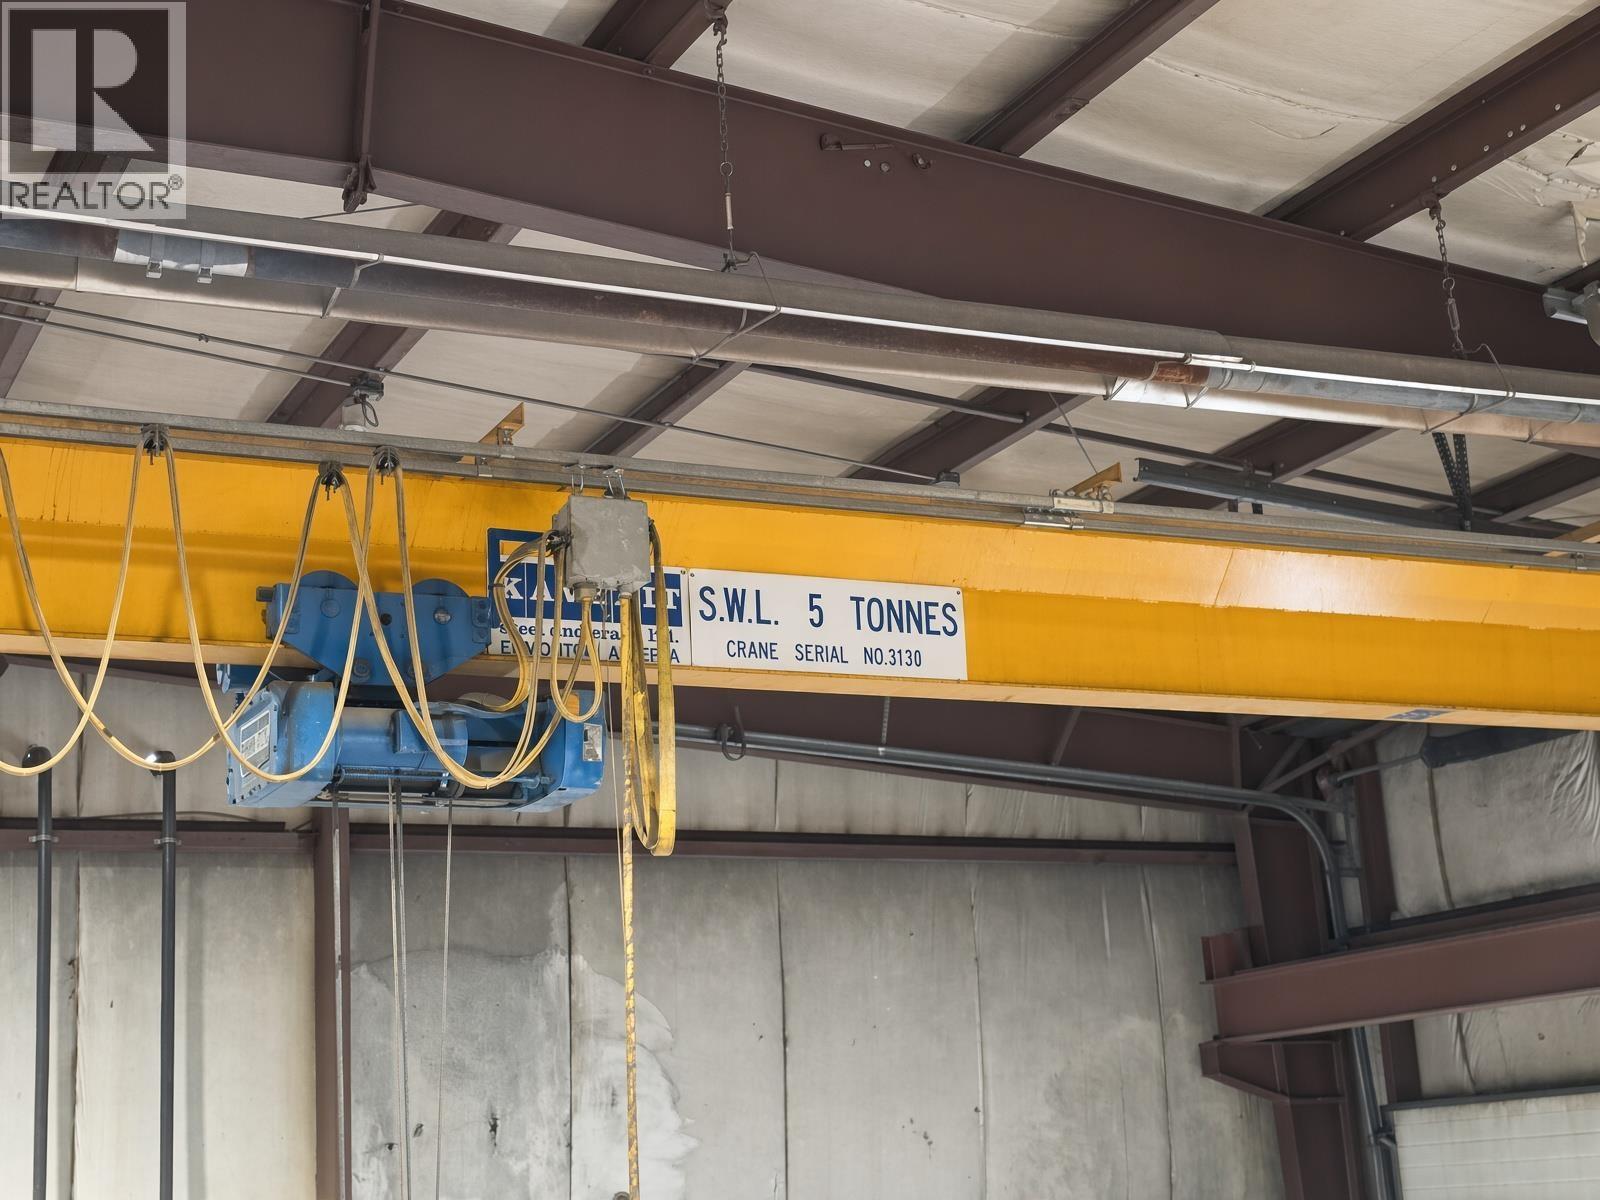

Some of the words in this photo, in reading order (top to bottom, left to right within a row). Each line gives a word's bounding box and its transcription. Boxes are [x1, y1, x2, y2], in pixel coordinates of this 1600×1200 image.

[502, 576, 681, 610] KAVIT
[698, 585, 779, 626] S.W.L.
[808, 593, 824, 628] 5
[849, 596, 959, 637] TONNES
[726, 640, 779, 660] CRANE
[794, 644, 849, 664] SERIAL
[863, 646, 922, 667] NO.3130
